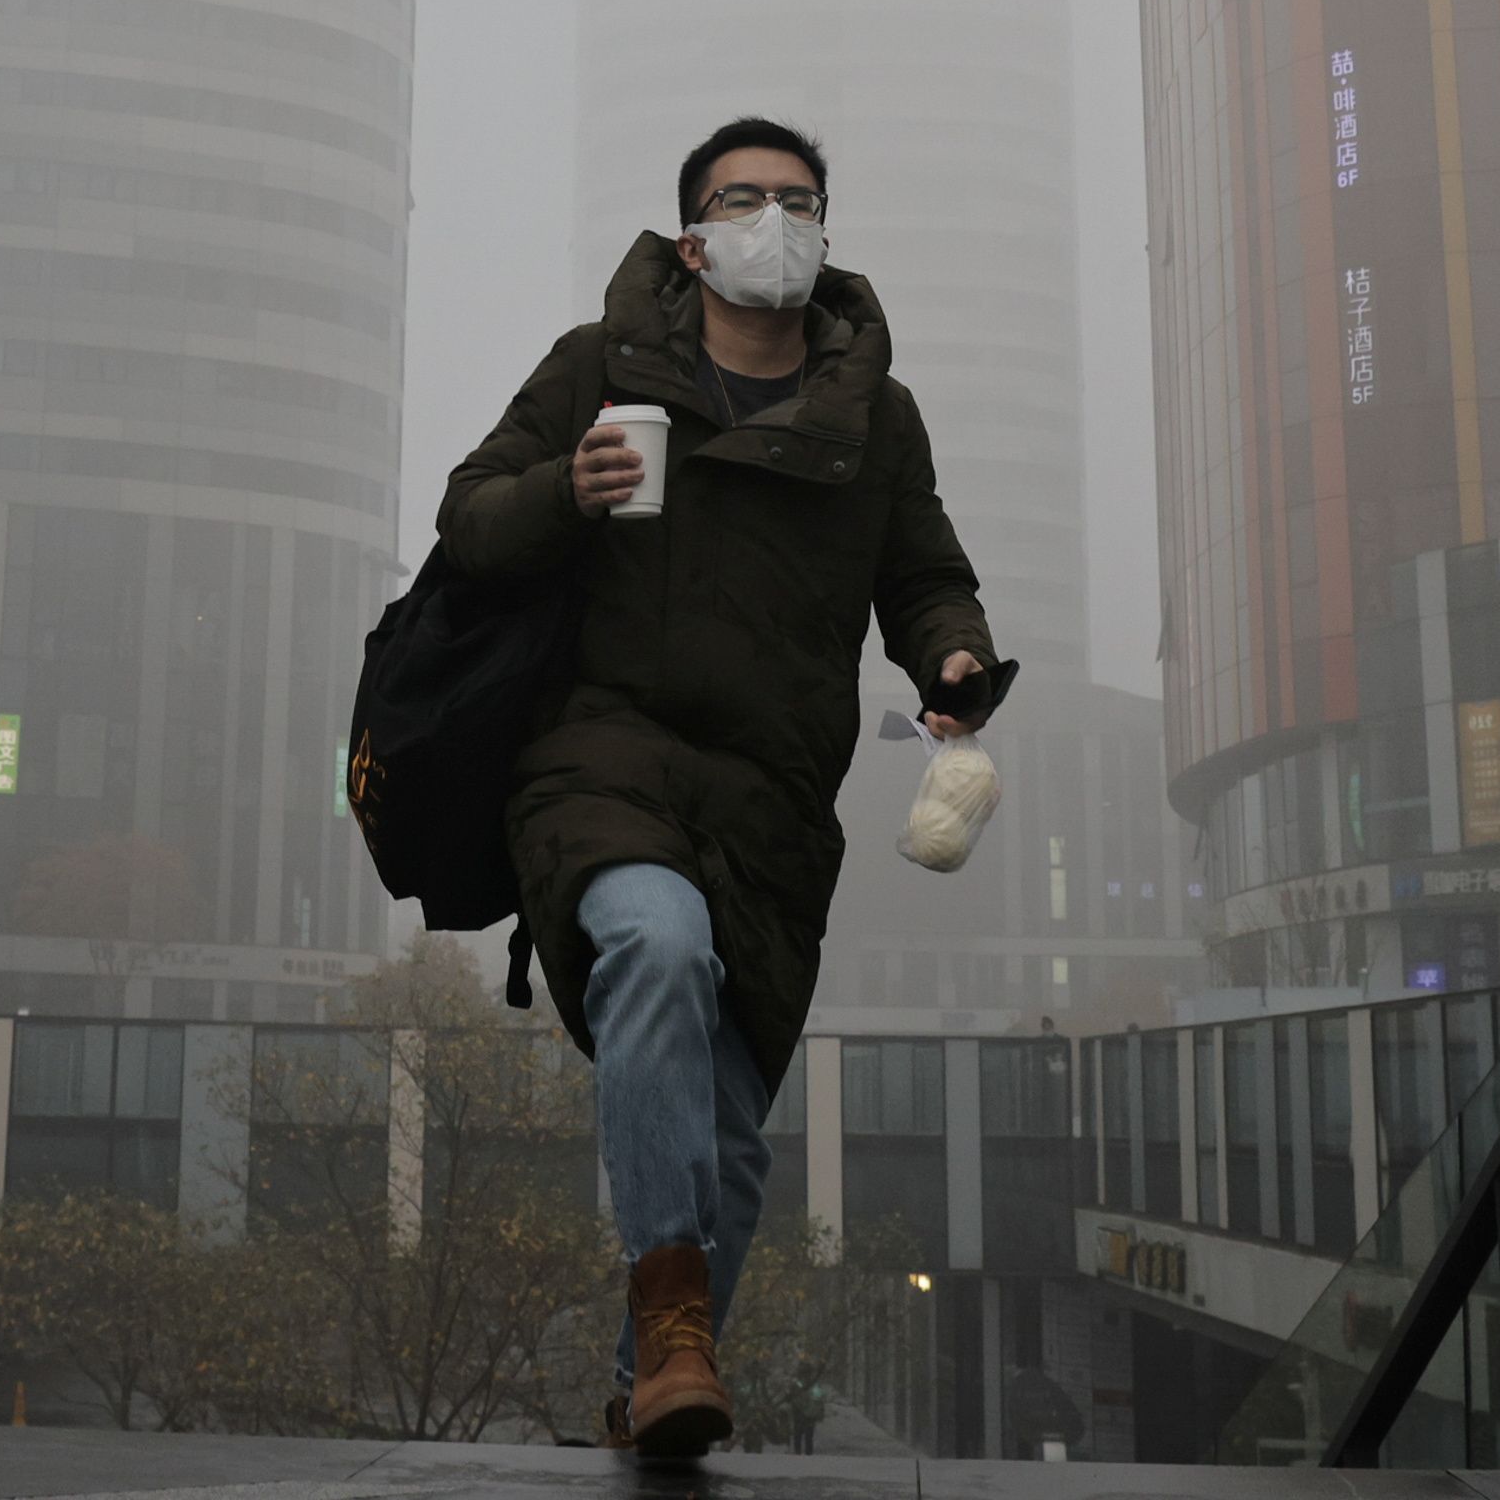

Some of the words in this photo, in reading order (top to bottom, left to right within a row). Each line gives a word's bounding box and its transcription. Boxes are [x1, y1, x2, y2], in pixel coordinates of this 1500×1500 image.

[1337, 169, 1359, 188] 6F
[1345, 267, 1373, 383] 桔子酒店
[1352, 386, 1374, 405] 5F
